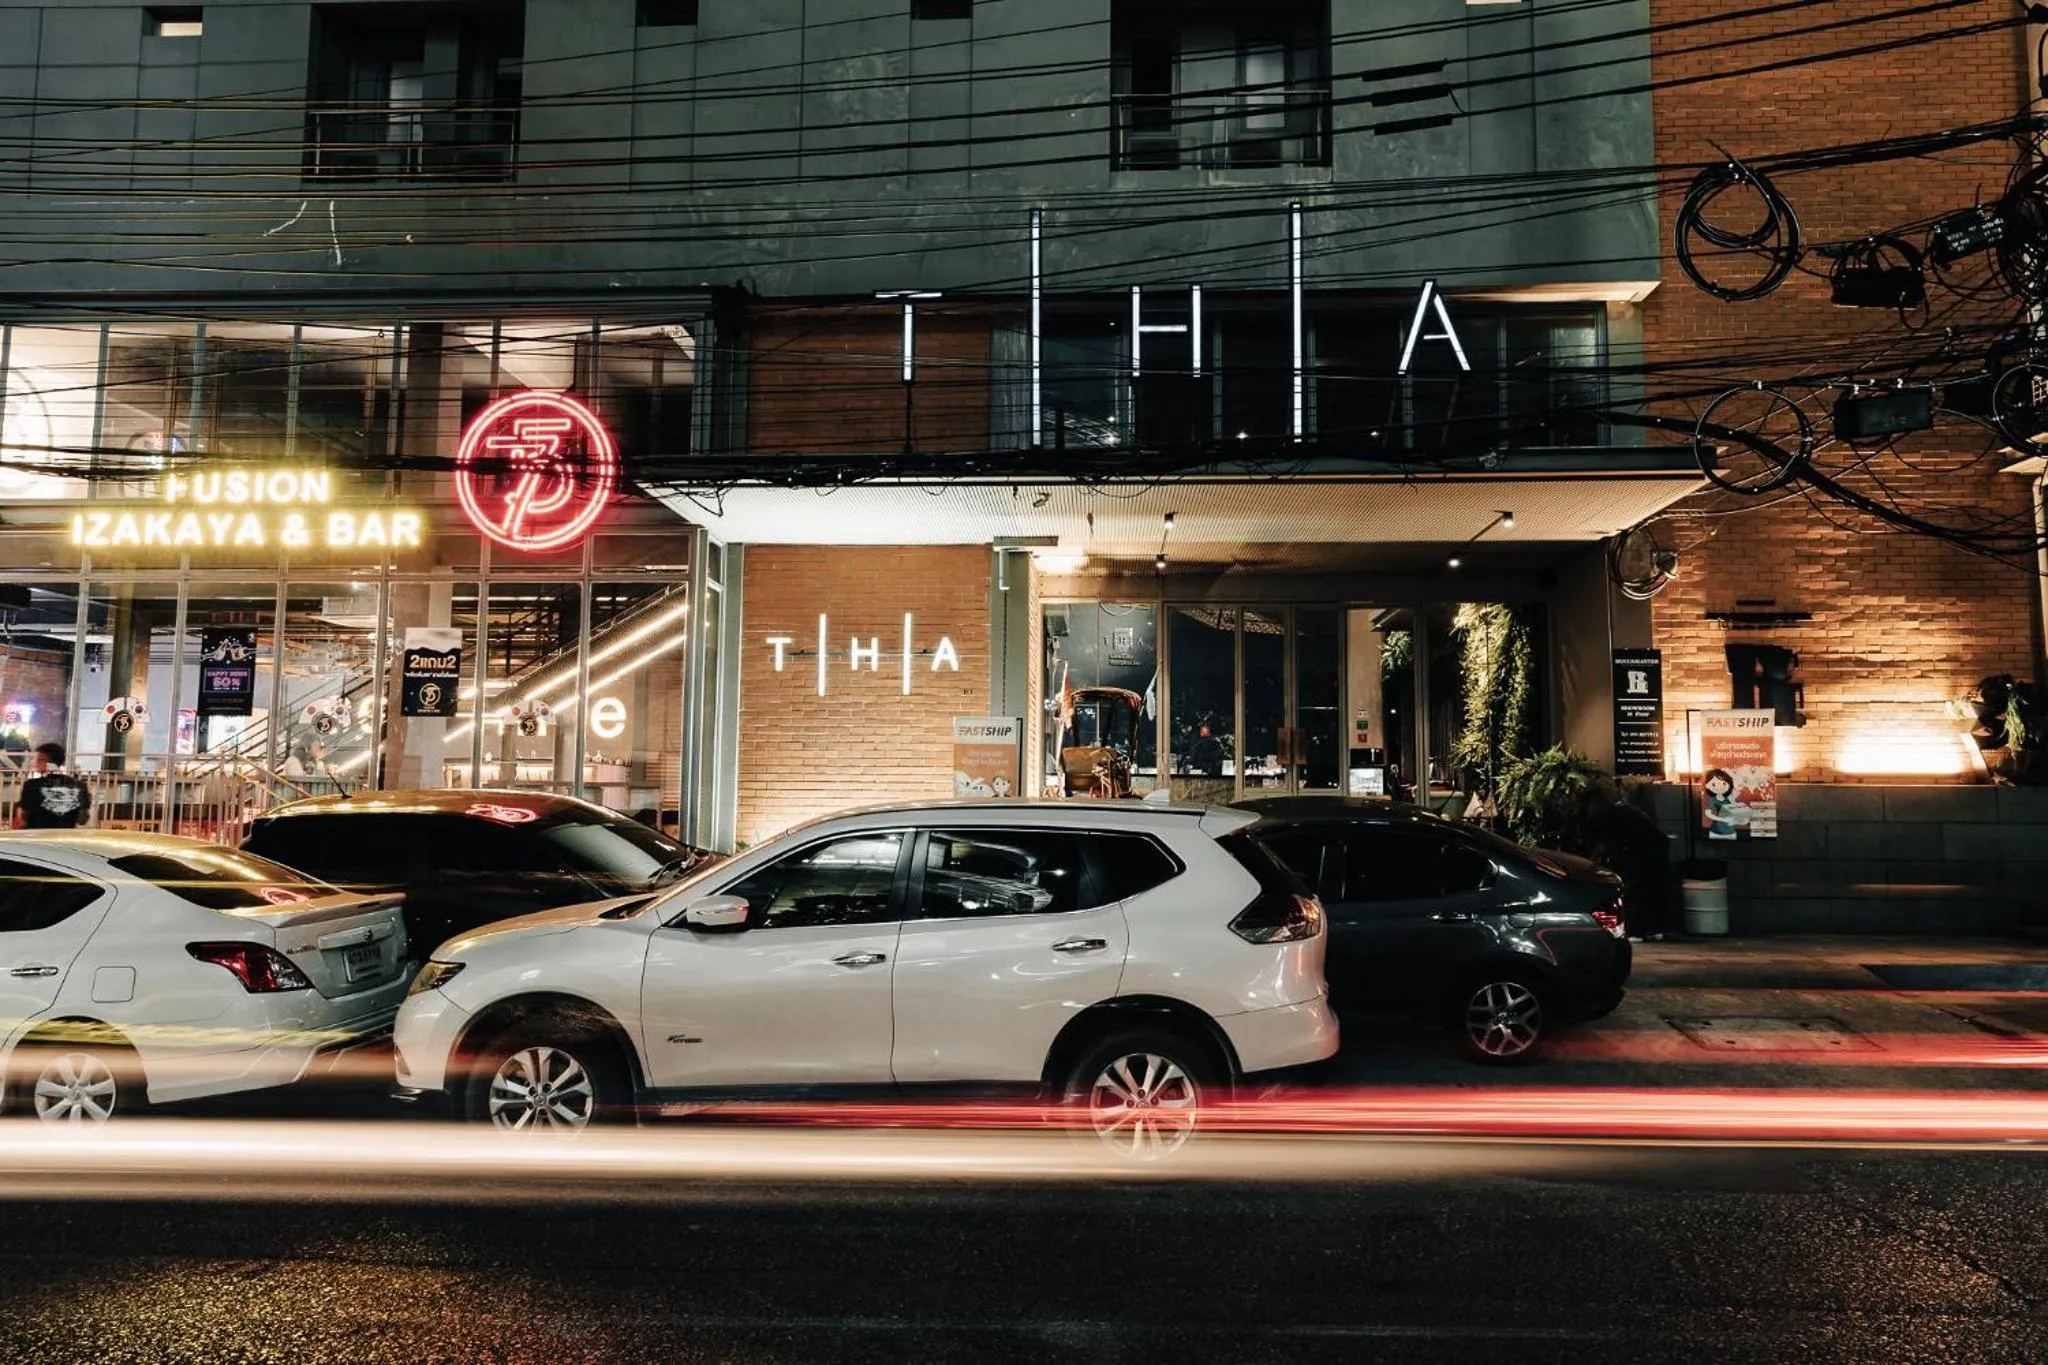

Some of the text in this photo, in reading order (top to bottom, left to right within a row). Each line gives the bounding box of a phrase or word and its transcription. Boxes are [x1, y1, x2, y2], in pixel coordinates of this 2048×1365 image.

[165, 470, 330, 503] FUSION
[71, 512, 421, 547] IZAKAYA & BAR
[959, 726, 1012, 737] FASTSHIP
[1706, 717, 1769, 728] FASTSHIP
